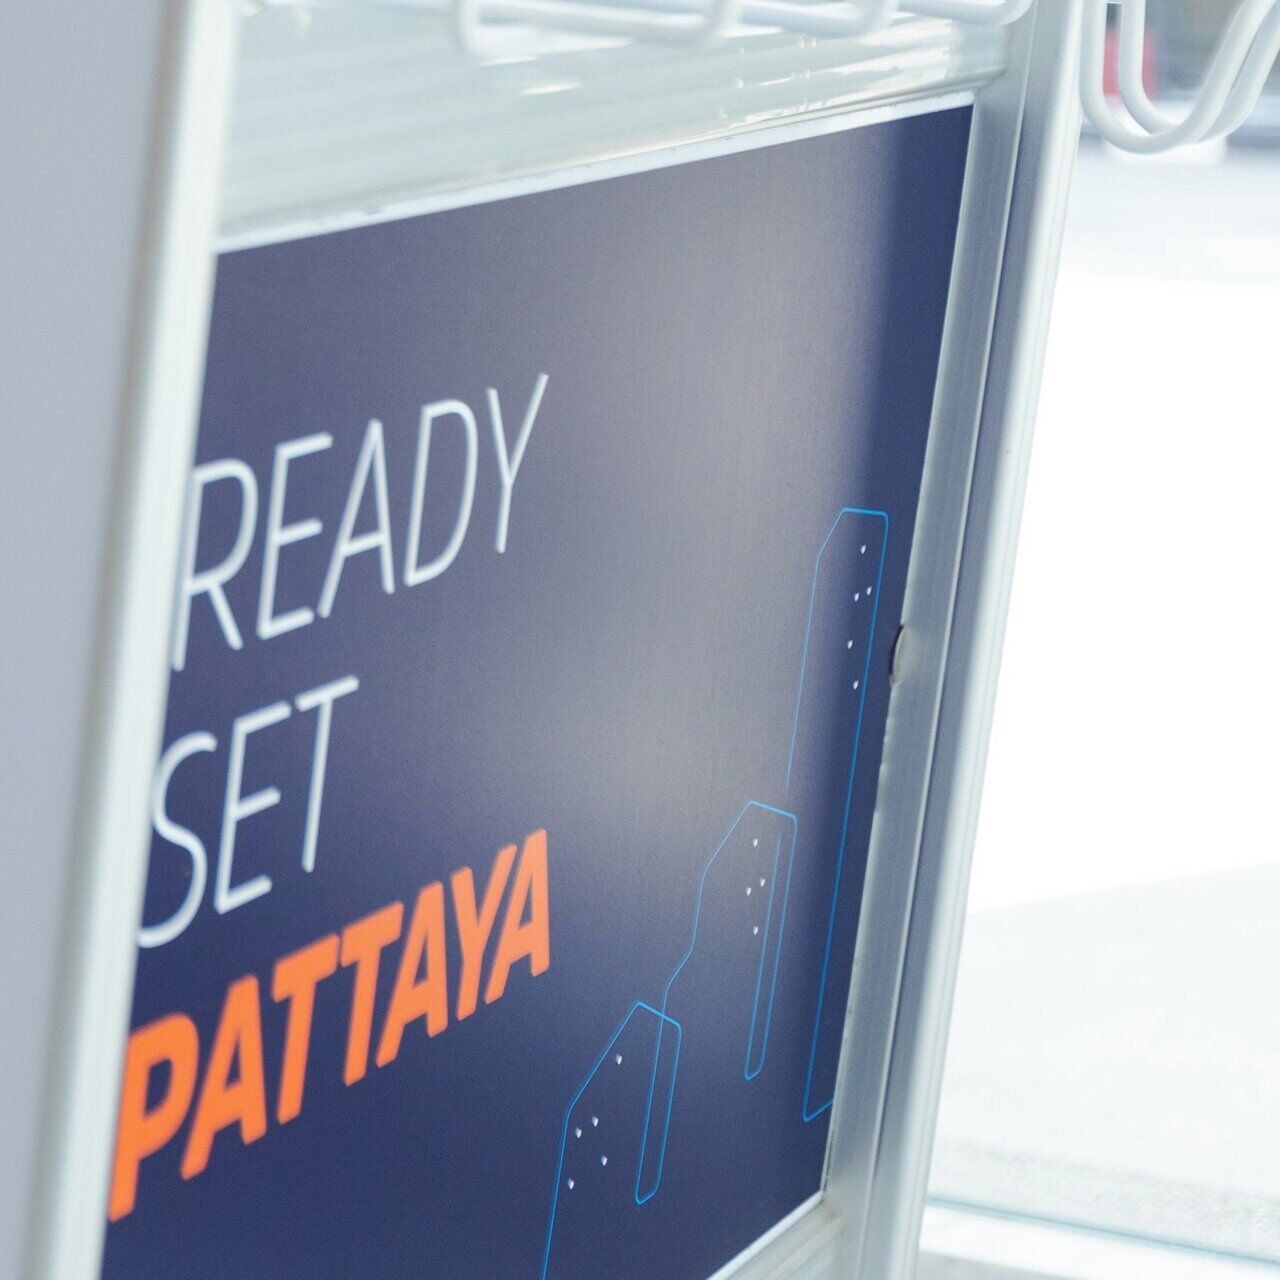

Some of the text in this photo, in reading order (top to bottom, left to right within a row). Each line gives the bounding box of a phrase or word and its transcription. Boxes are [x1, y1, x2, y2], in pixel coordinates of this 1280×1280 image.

[171, 373, 549, 672] READY
[136, 676, 359, 949] SET
[107, 828, 550, 1223] PATTAYA
